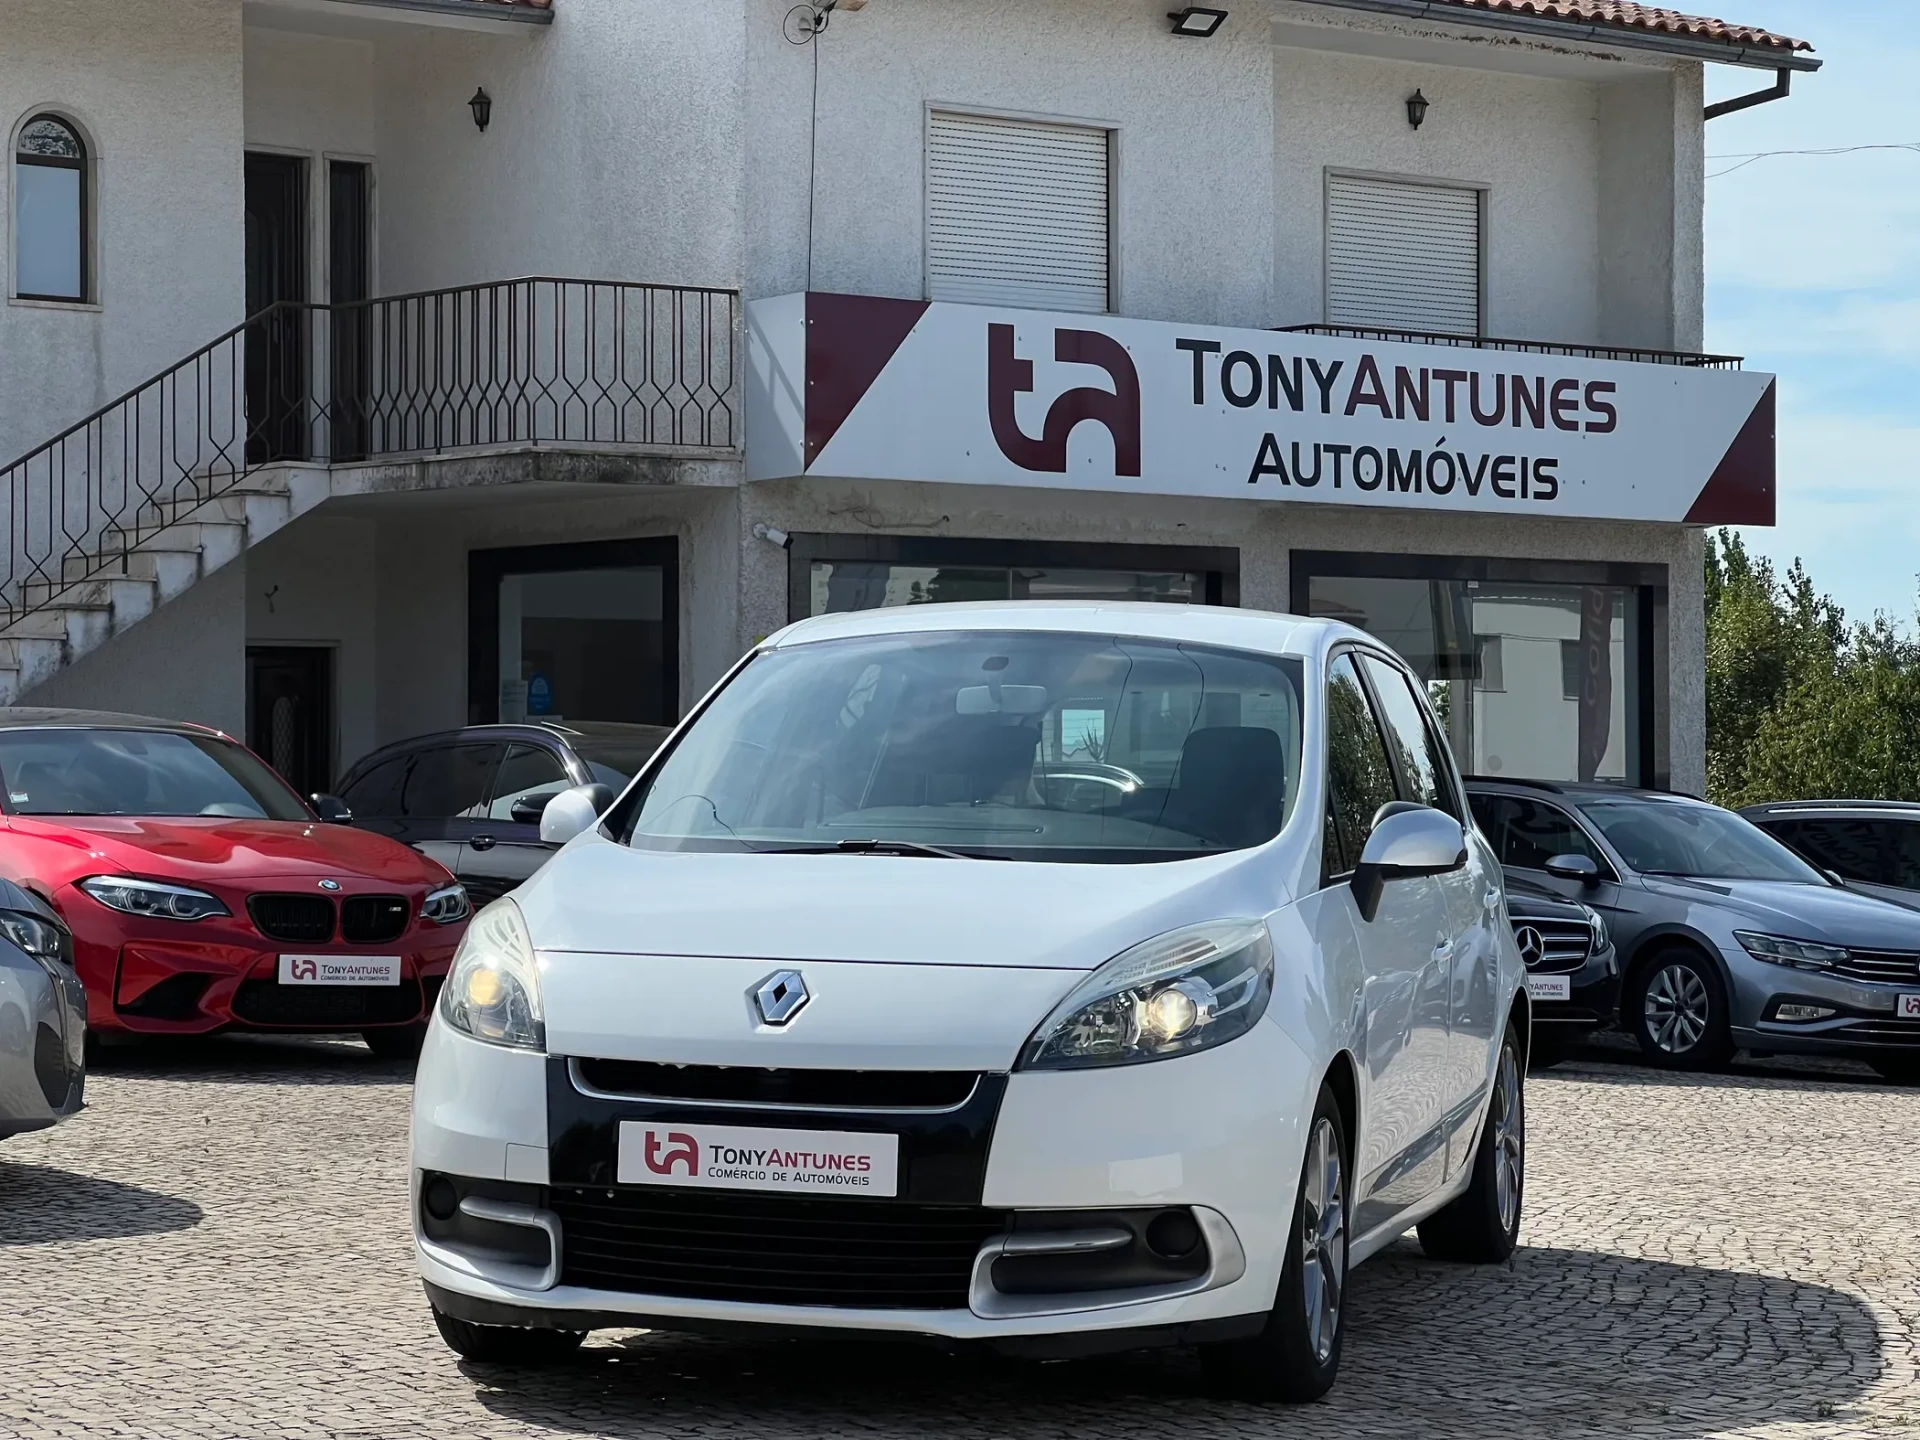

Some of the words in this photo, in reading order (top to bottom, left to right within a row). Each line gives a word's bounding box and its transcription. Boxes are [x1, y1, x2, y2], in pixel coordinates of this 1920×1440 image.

[1175, 337, 1618, 434] TONYANTUNES
[1247, 432, 1560, 501] AUTOMÓVEIS
[1529, 982, 1563, 991] YANTUNES
[708, 1144, 871, 1172] TONYANTUNES
[707, 1167, 767, 1181] COMÉRCIO
[772, 1171, 788, 1182] DE
[793, 1171, 870, 1186] AUTOMÓVEIS
